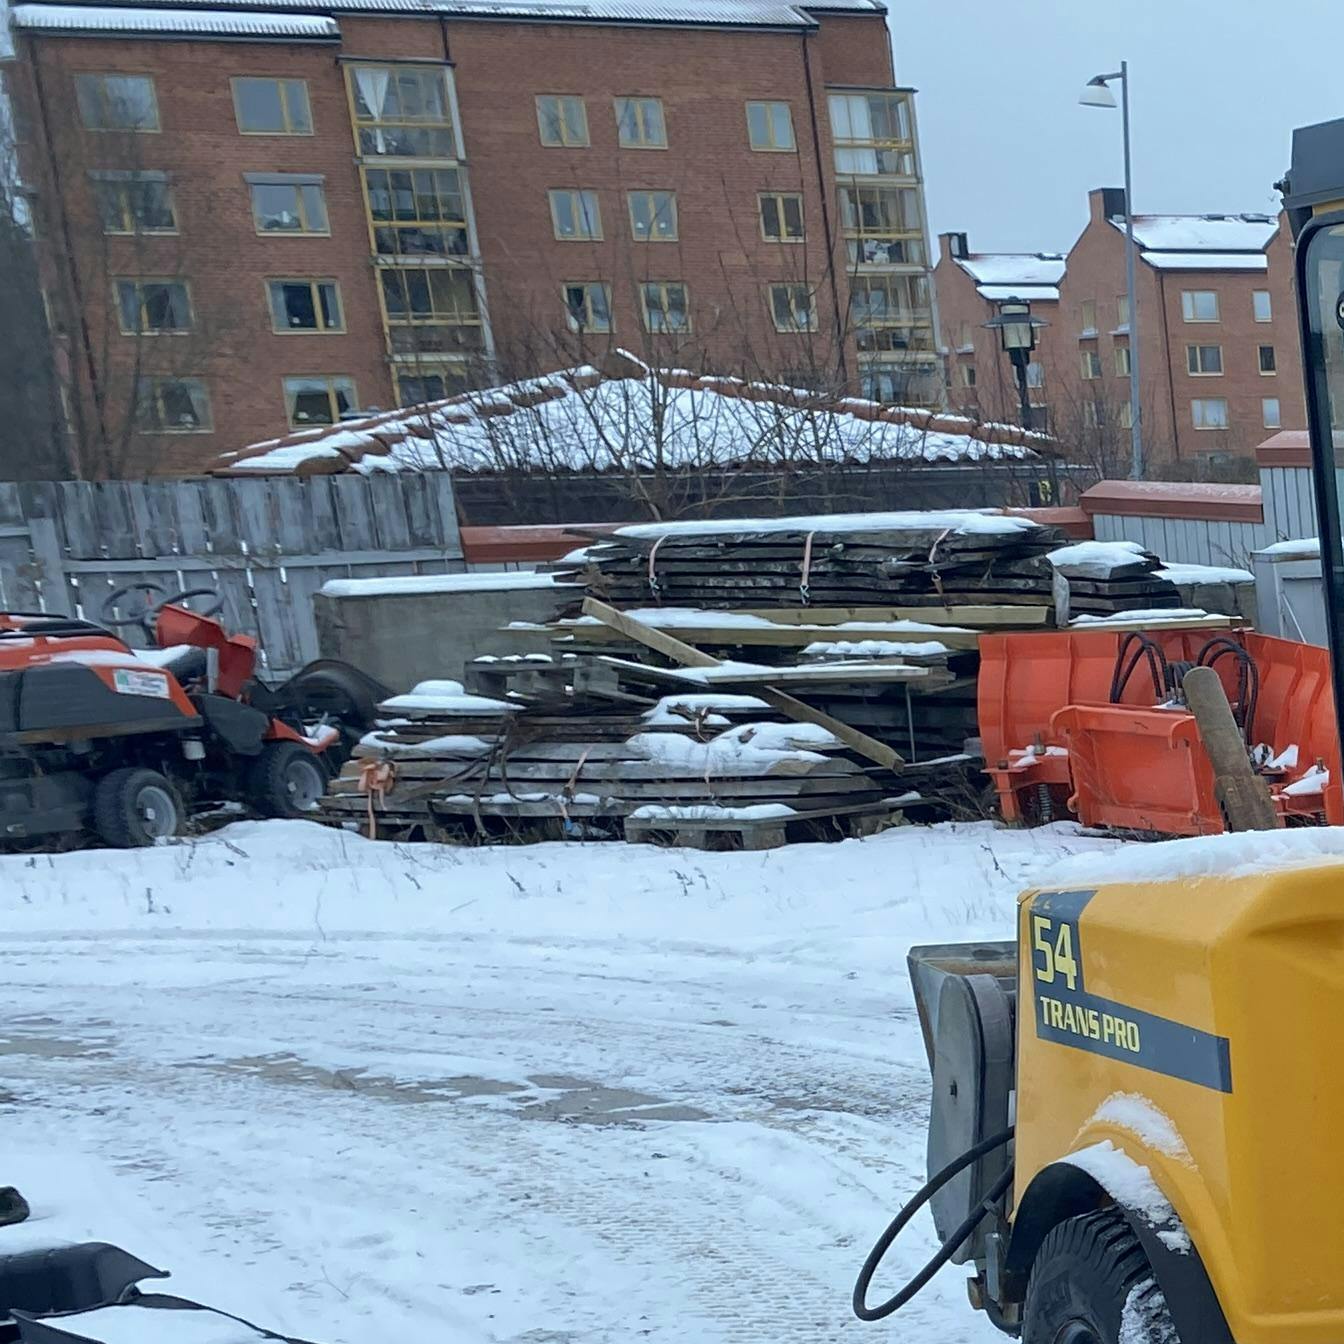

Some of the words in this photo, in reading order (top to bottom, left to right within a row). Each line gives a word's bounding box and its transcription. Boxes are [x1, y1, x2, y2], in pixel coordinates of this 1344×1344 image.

[1033, 915, 1078, 991] 54
[1039, 996, 1101, 1041] TRANS
[1102, 1013, 1141, 1054] PRO
